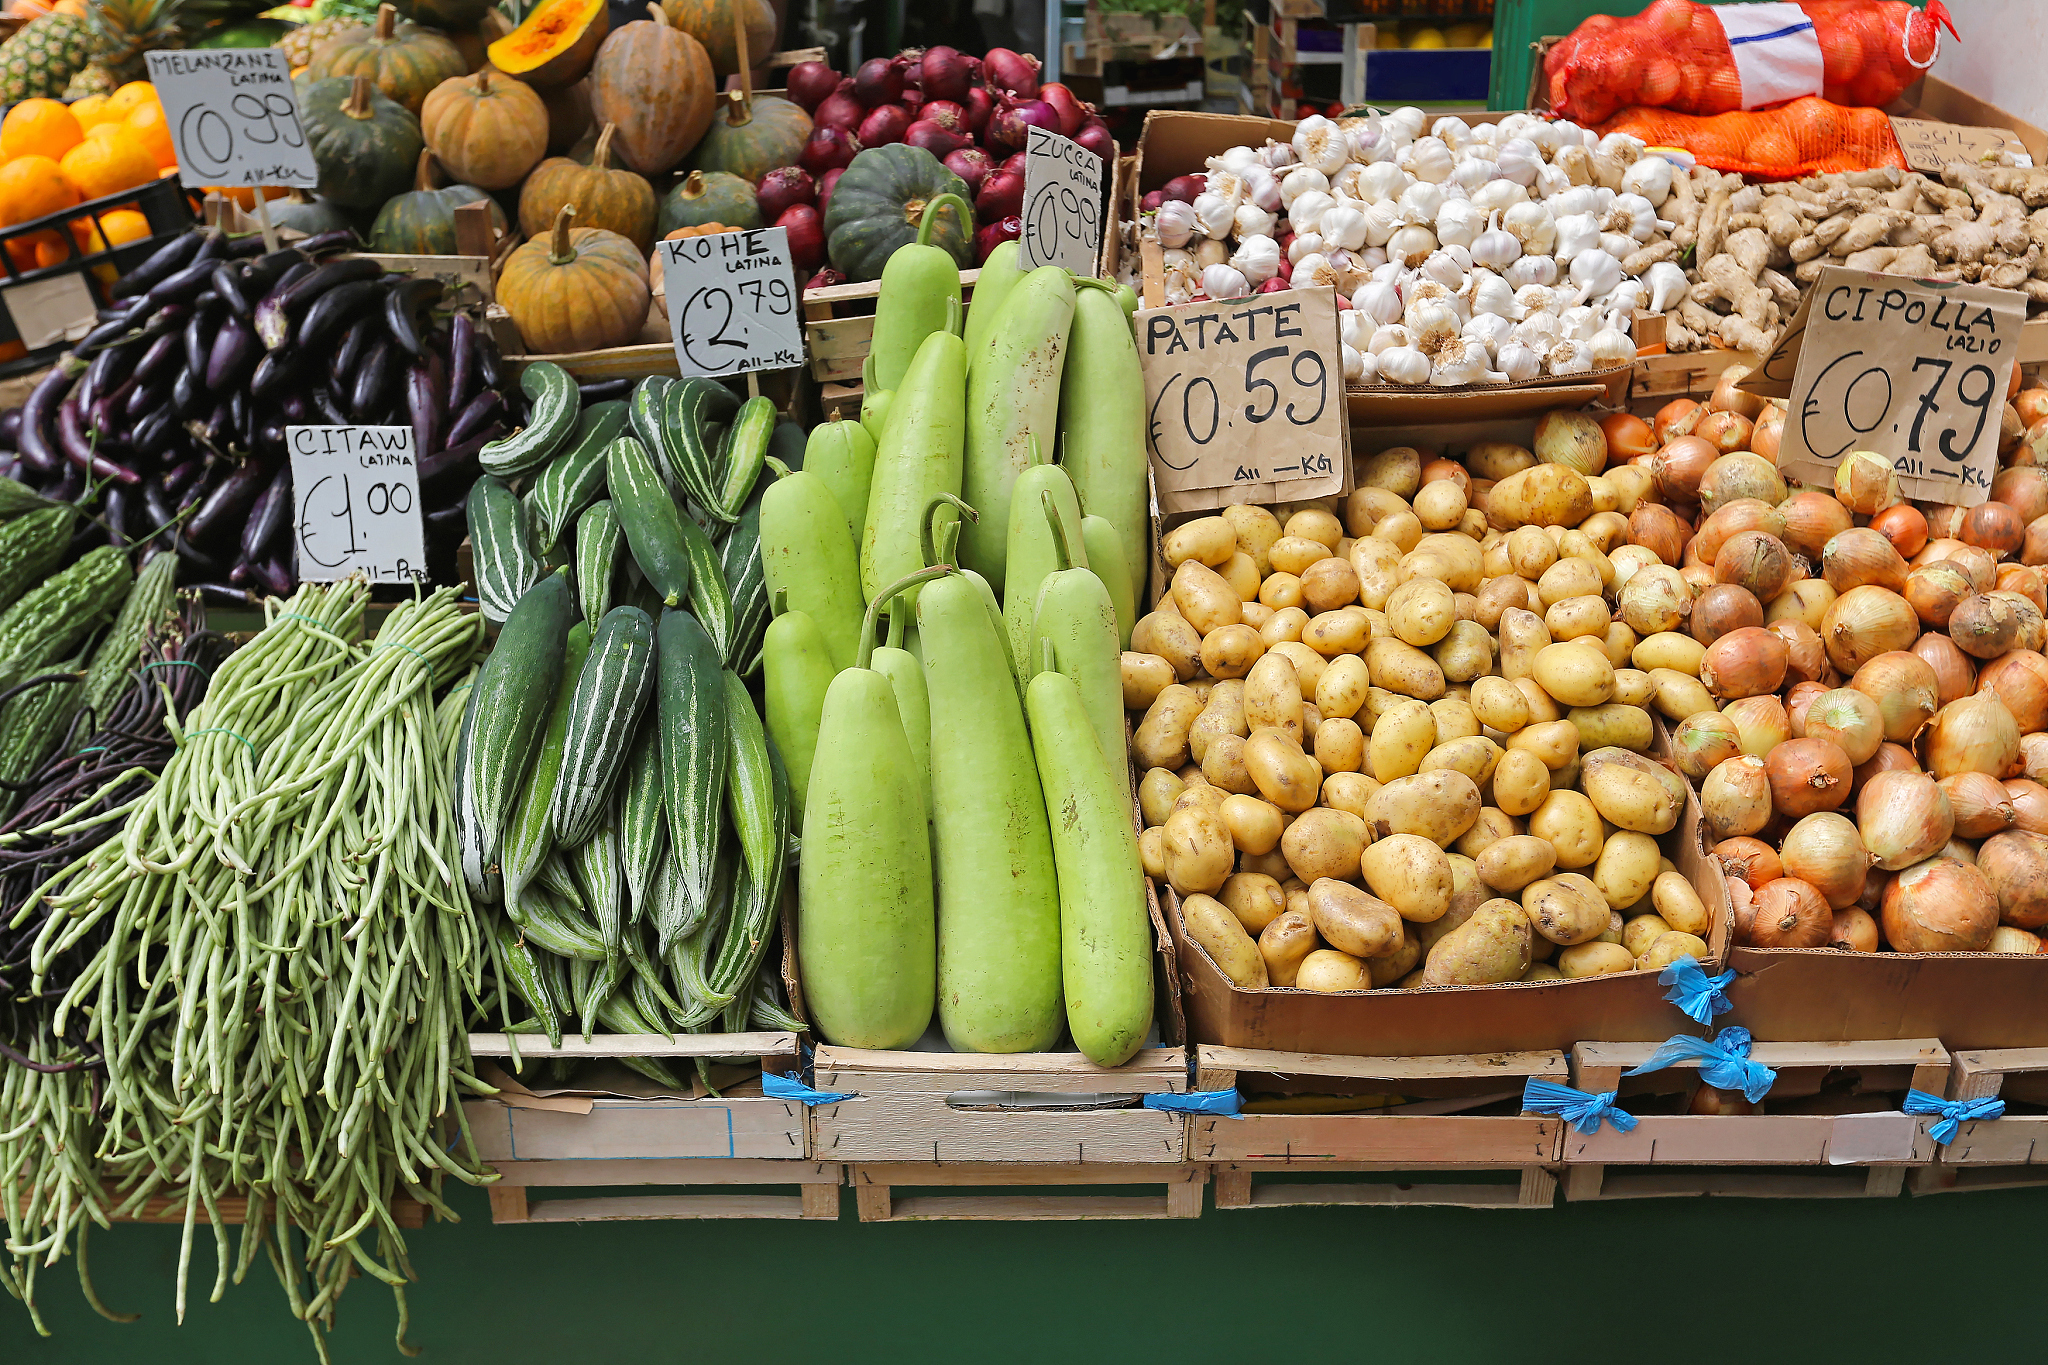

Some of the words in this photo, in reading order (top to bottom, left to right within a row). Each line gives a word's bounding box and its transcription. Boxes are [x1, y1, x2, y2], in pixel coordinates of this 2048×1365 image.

[151, 53, 277, 76] MELANZANI
[1030, 131, 1096, 174] ZUCCA
[1069, 168, 1098, 194] LATINA
[669, 230, 769, 264] KOHE
[726, 256, 782, 273] LATINA
[1824, 286, 1995, 334] CIPOLLA
[1147, 303, 1302, 355] PATATE
[1946, 335, 2001, 355] LAZIO
[1150, 345, 1327, 471] €0.59
[1801, 350, 1996, 462] €0.79
[295, 428, 407, 456] CITAW
[360, 454, 412, 468] LATINA
[300, 473, 412, 567] €1.00
